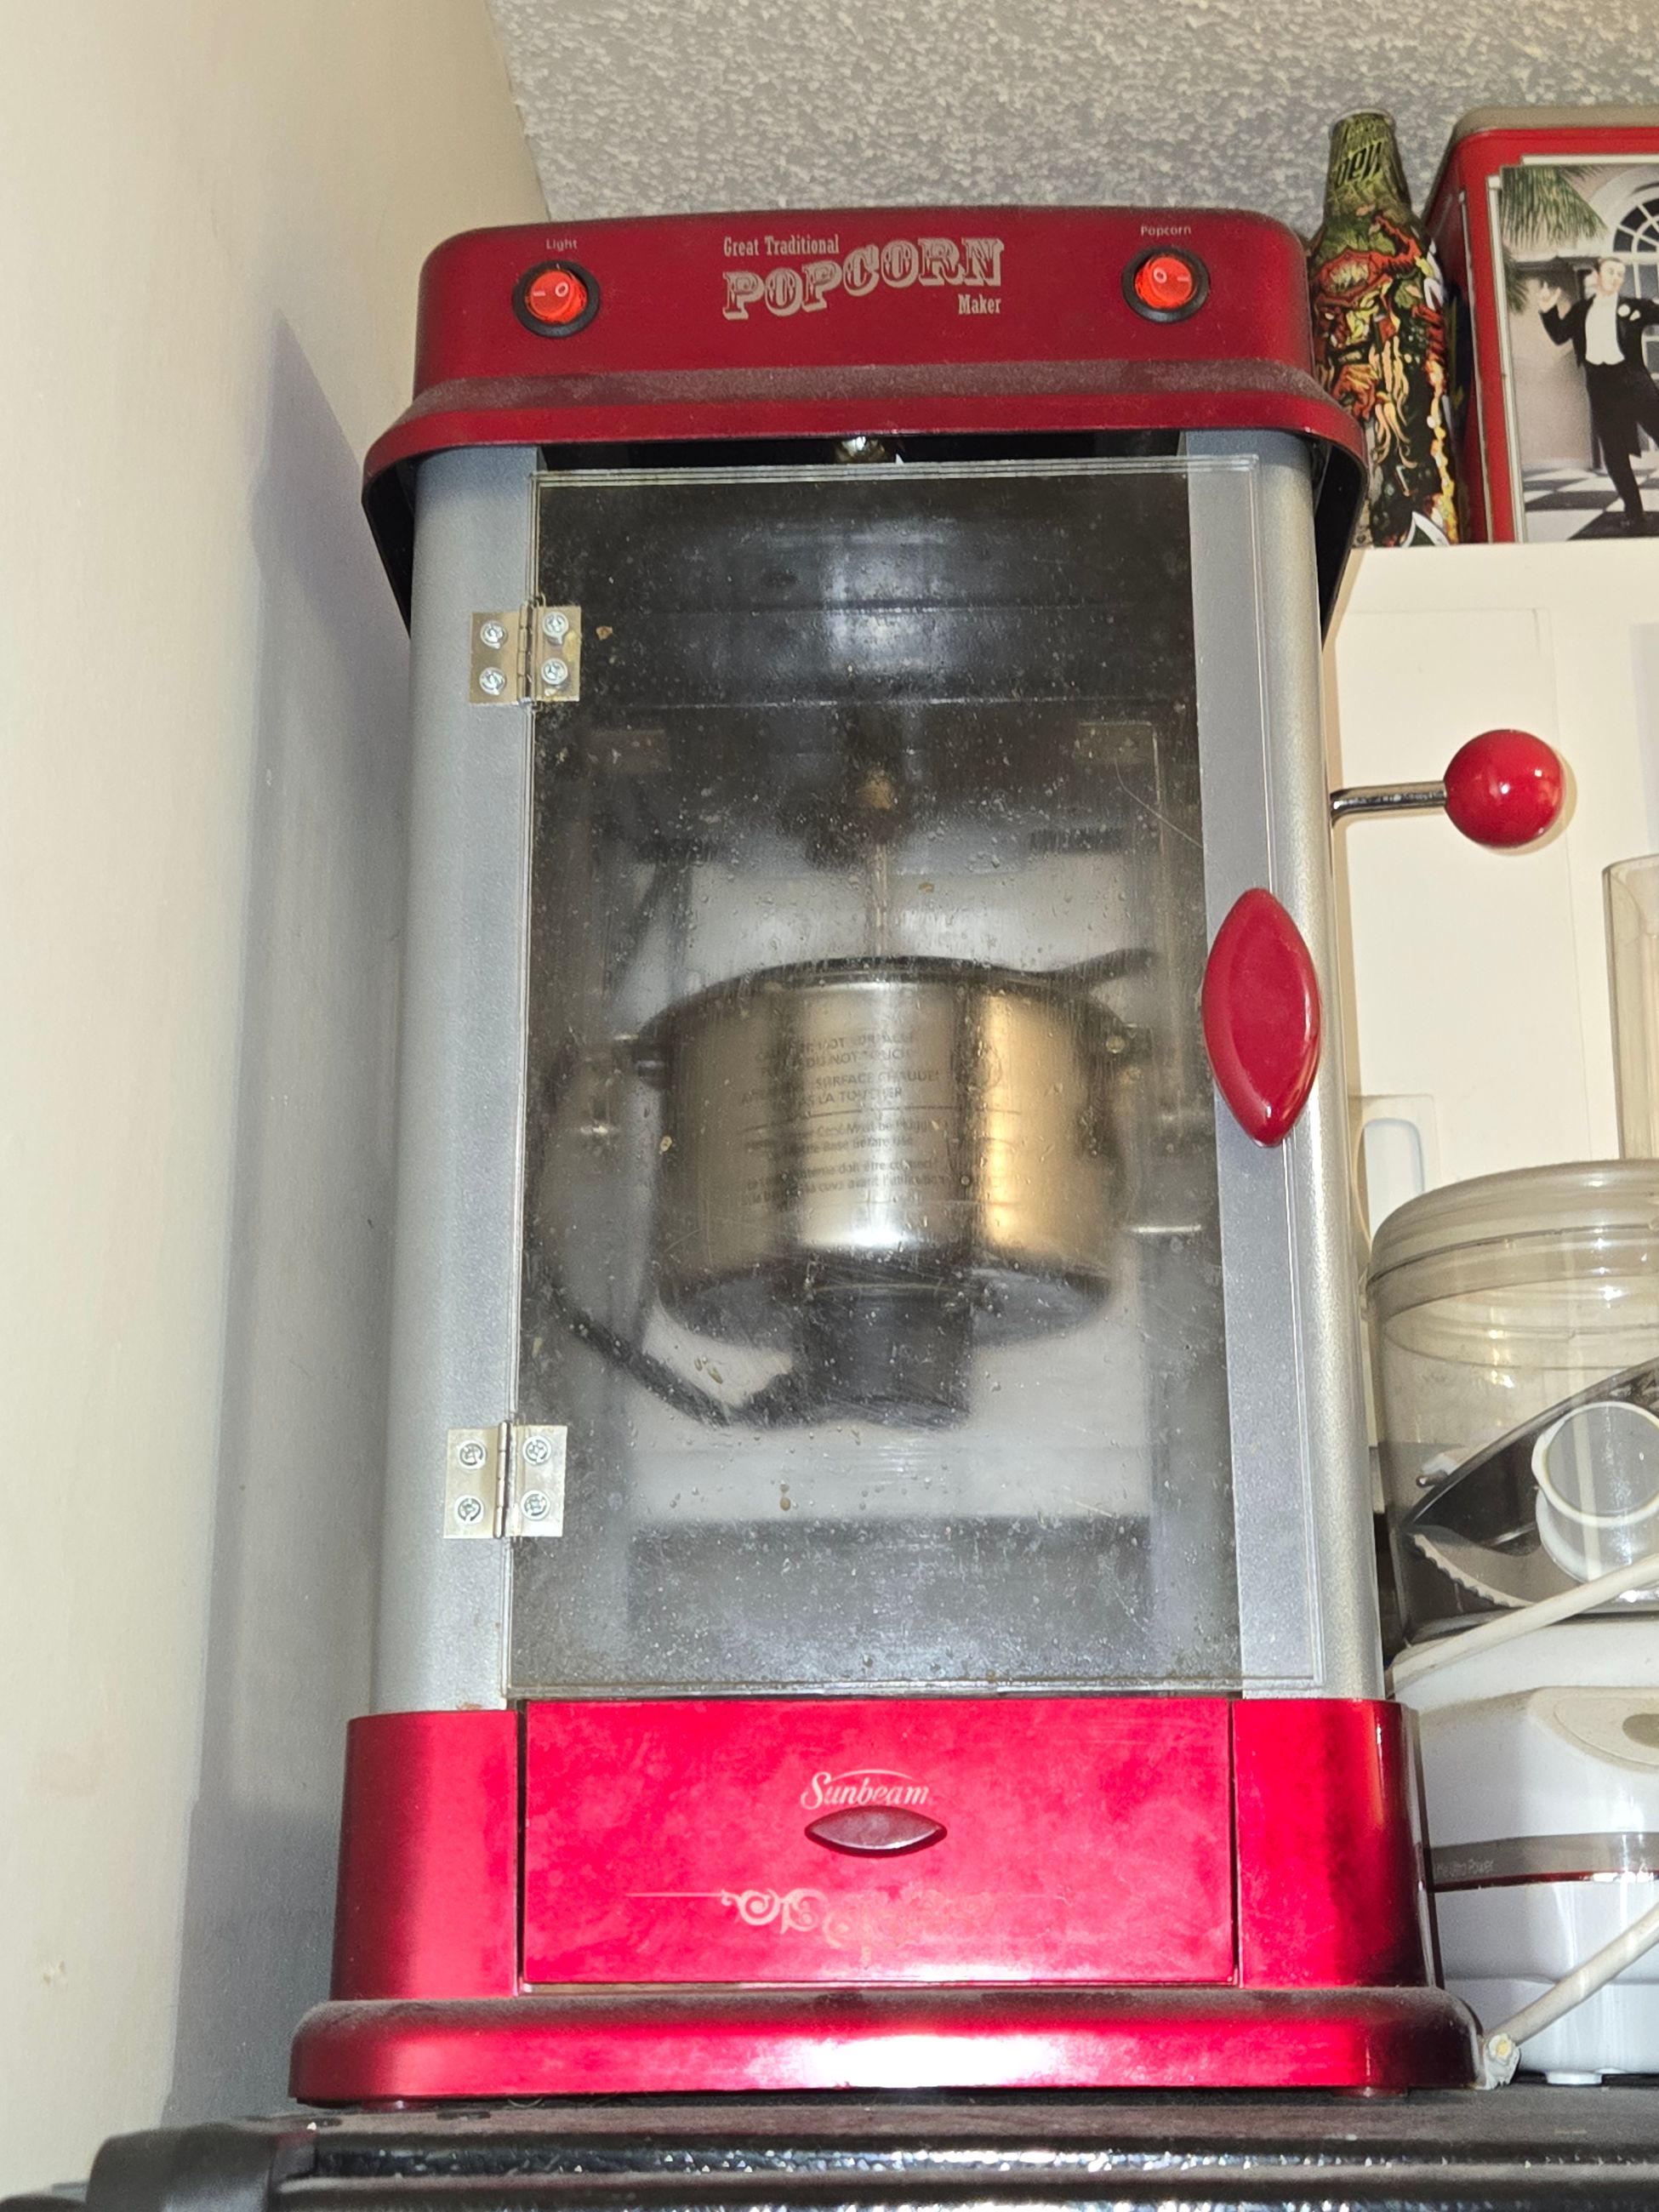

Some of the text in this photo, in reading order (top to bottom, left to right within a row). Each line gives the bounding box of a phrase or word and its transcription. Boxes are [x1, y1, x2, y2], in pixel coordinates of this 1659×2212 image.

[1140, 224, 1192, 237] Popcorn
[546, 238, 578, 252] Light
[723, 234, 841, 256] Great Traditional
[722, 237, 1005, 321] POPCORN
[958, 294, 1001, 315] Maker
[801, 1770, 930, 1810] Sunbeam
